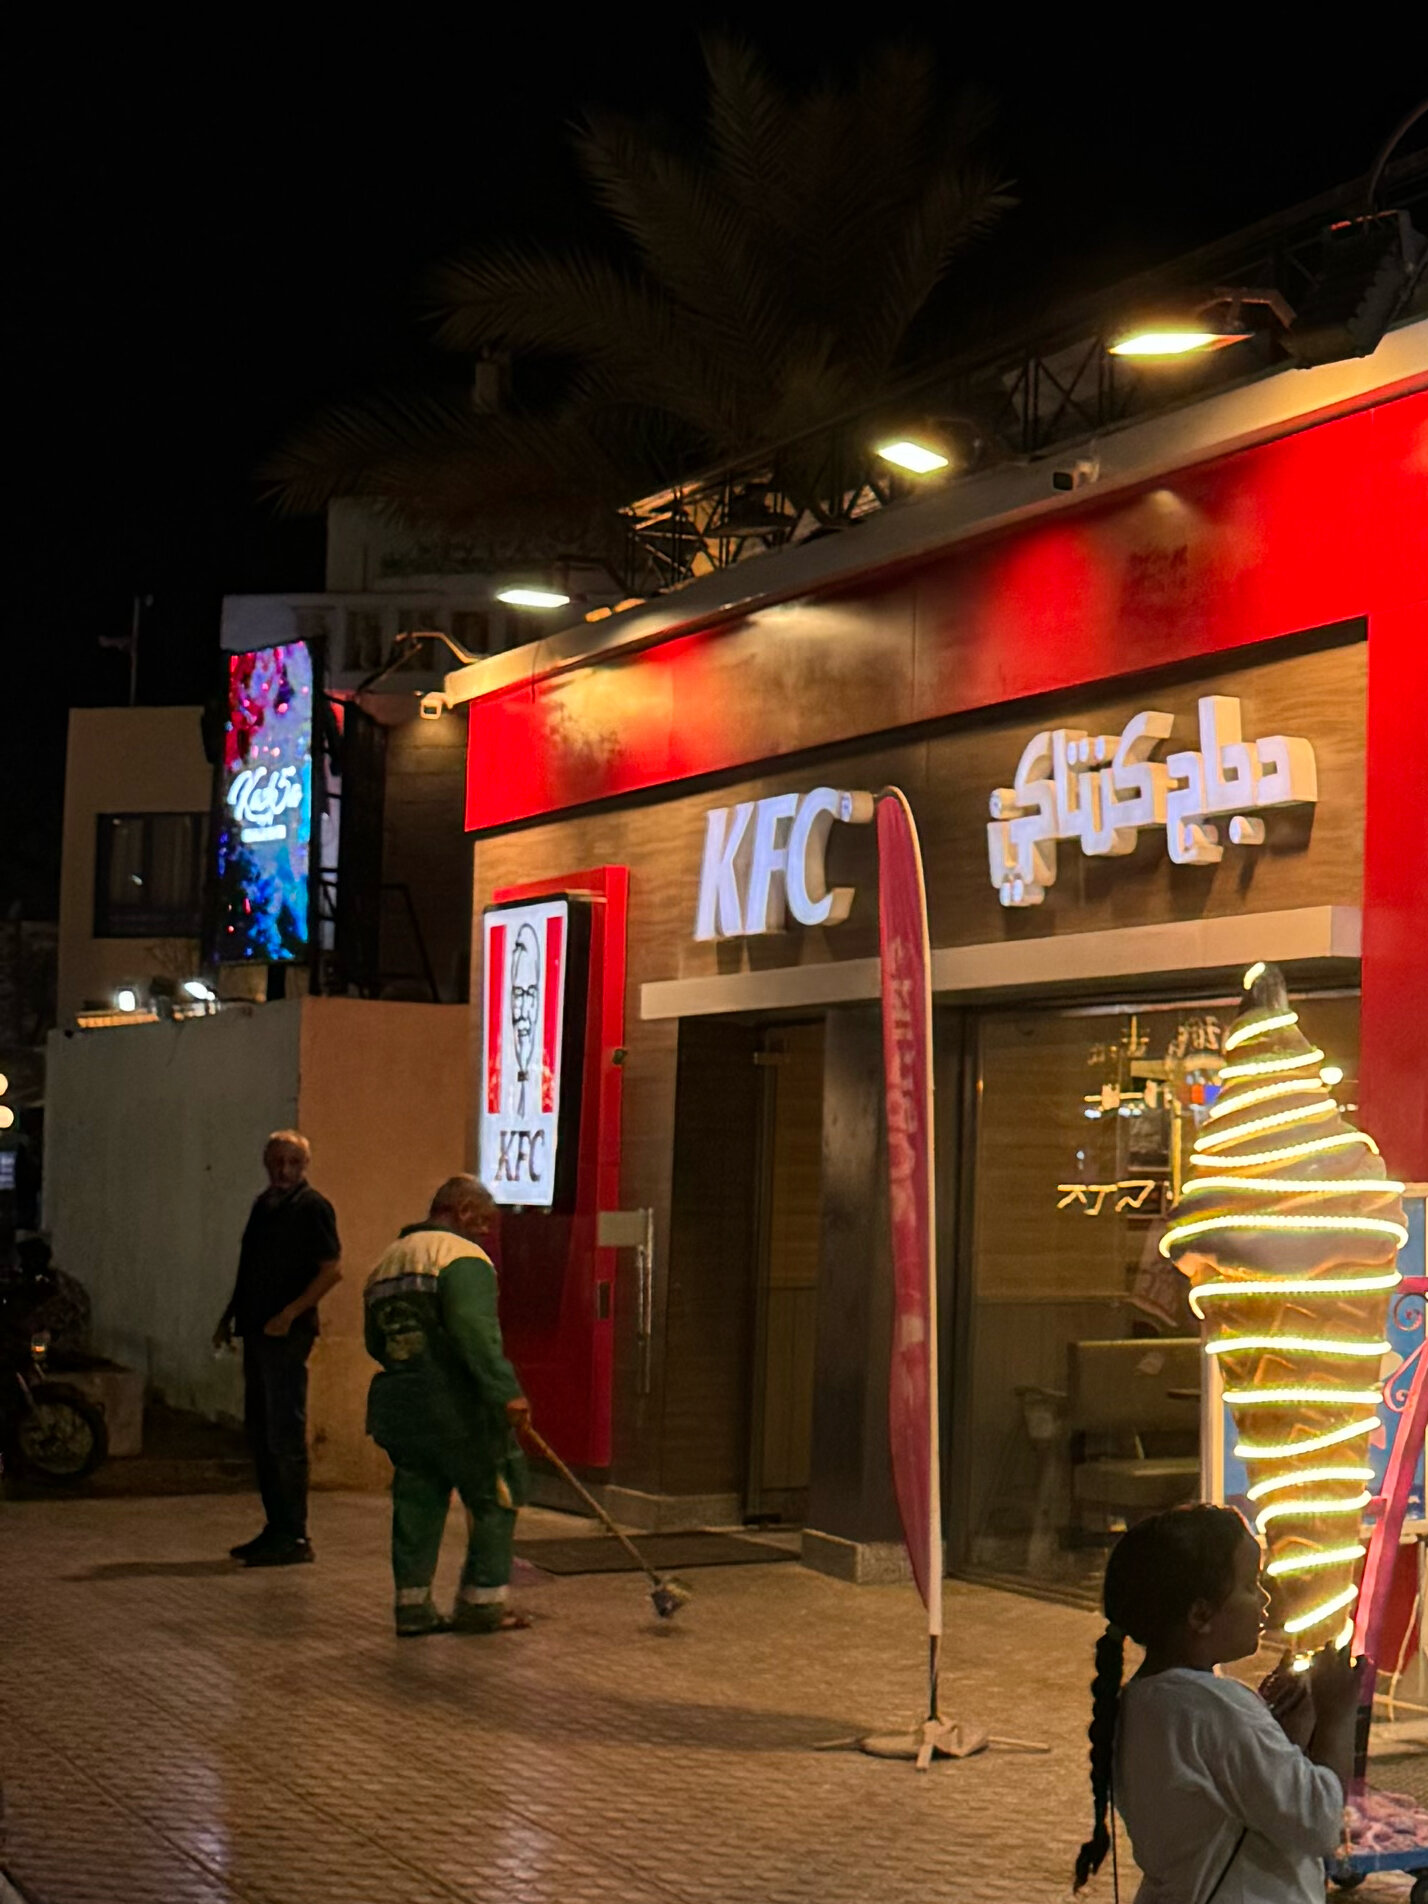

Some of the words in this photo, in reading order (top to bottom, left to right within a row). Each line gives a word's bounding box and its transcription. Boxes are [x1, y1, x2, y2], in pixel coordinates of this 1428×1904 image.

[987, 710, 1175, 907] كنتاكي
[1166, 695, 1317, 865] دجاج
[693, 788, 858, 942] KFC
[494, 1129, 546, 1182] KFC
